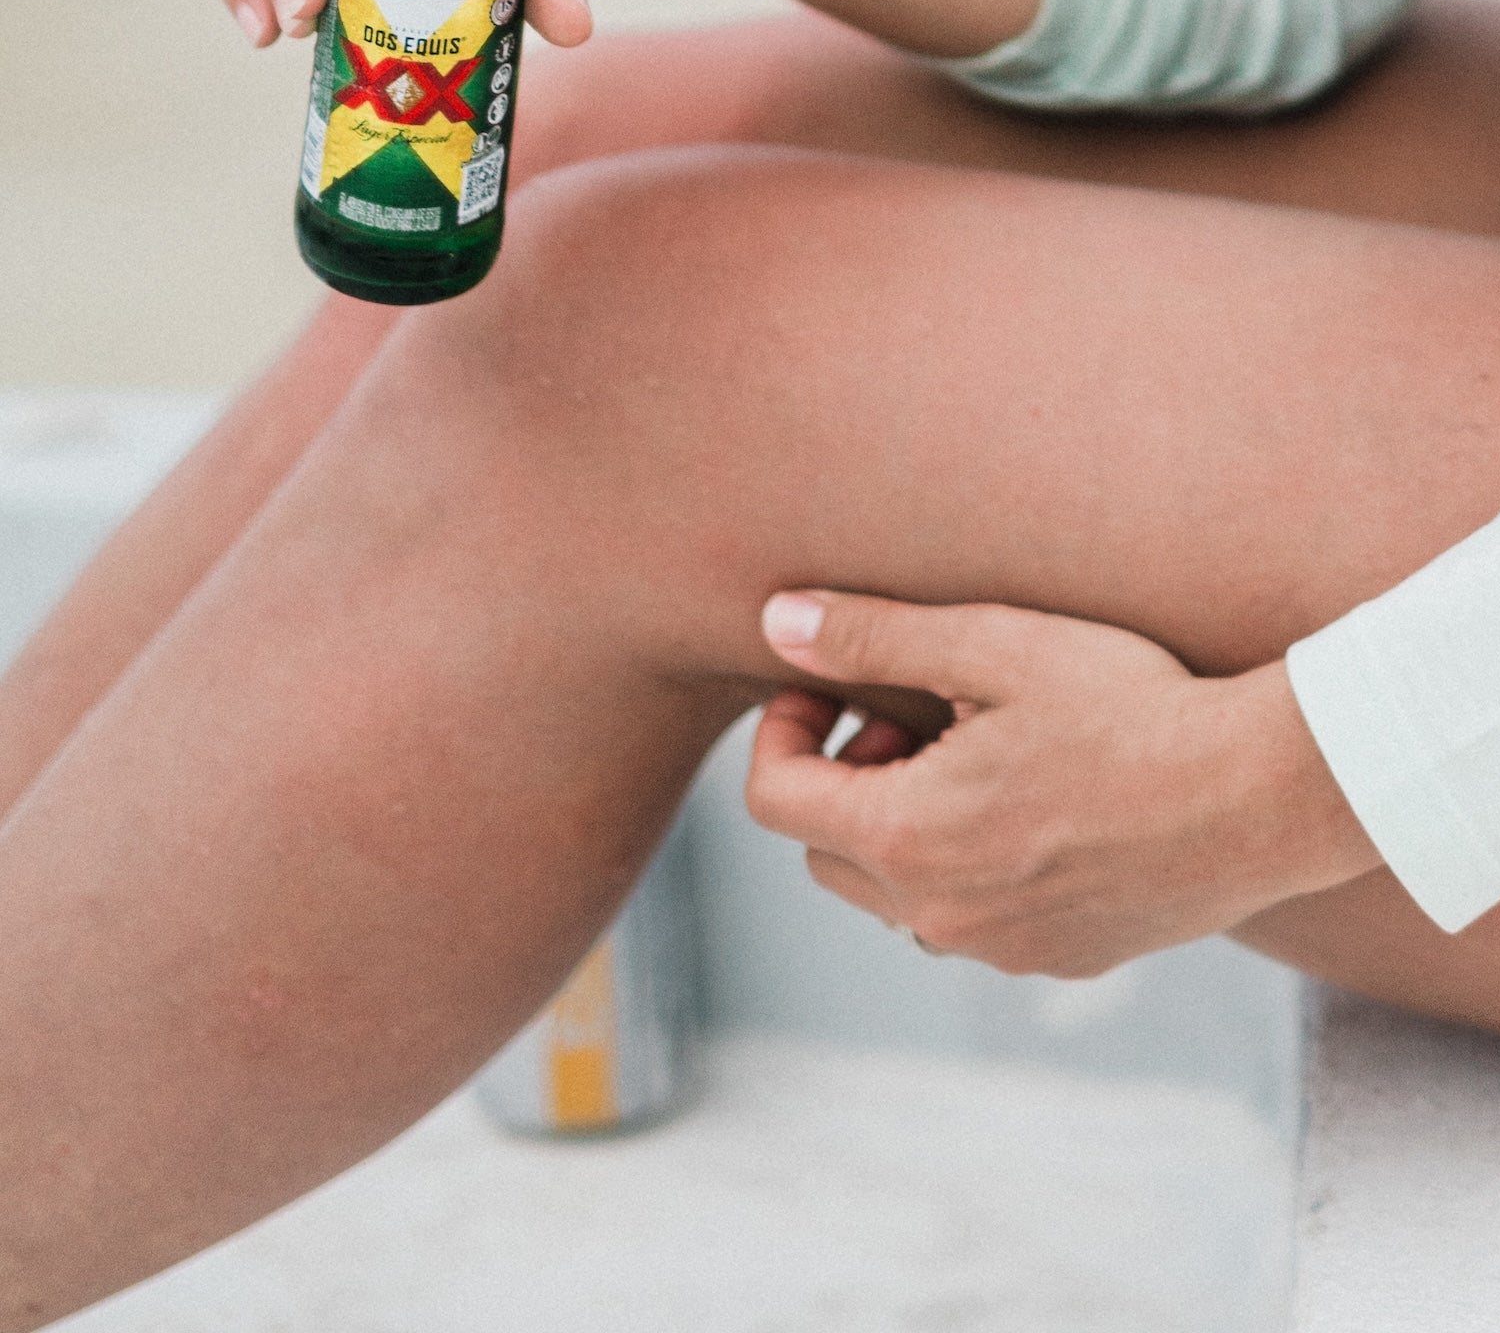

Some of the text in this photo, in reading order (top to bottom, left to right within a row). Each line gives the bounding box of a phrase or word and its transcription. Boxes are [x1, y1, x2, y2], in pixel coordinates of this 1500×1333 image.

[363, 23, 398, 51] DOS
[404, 36, 461, 56] EQUIS
[333, 35, 485, 126] XX
